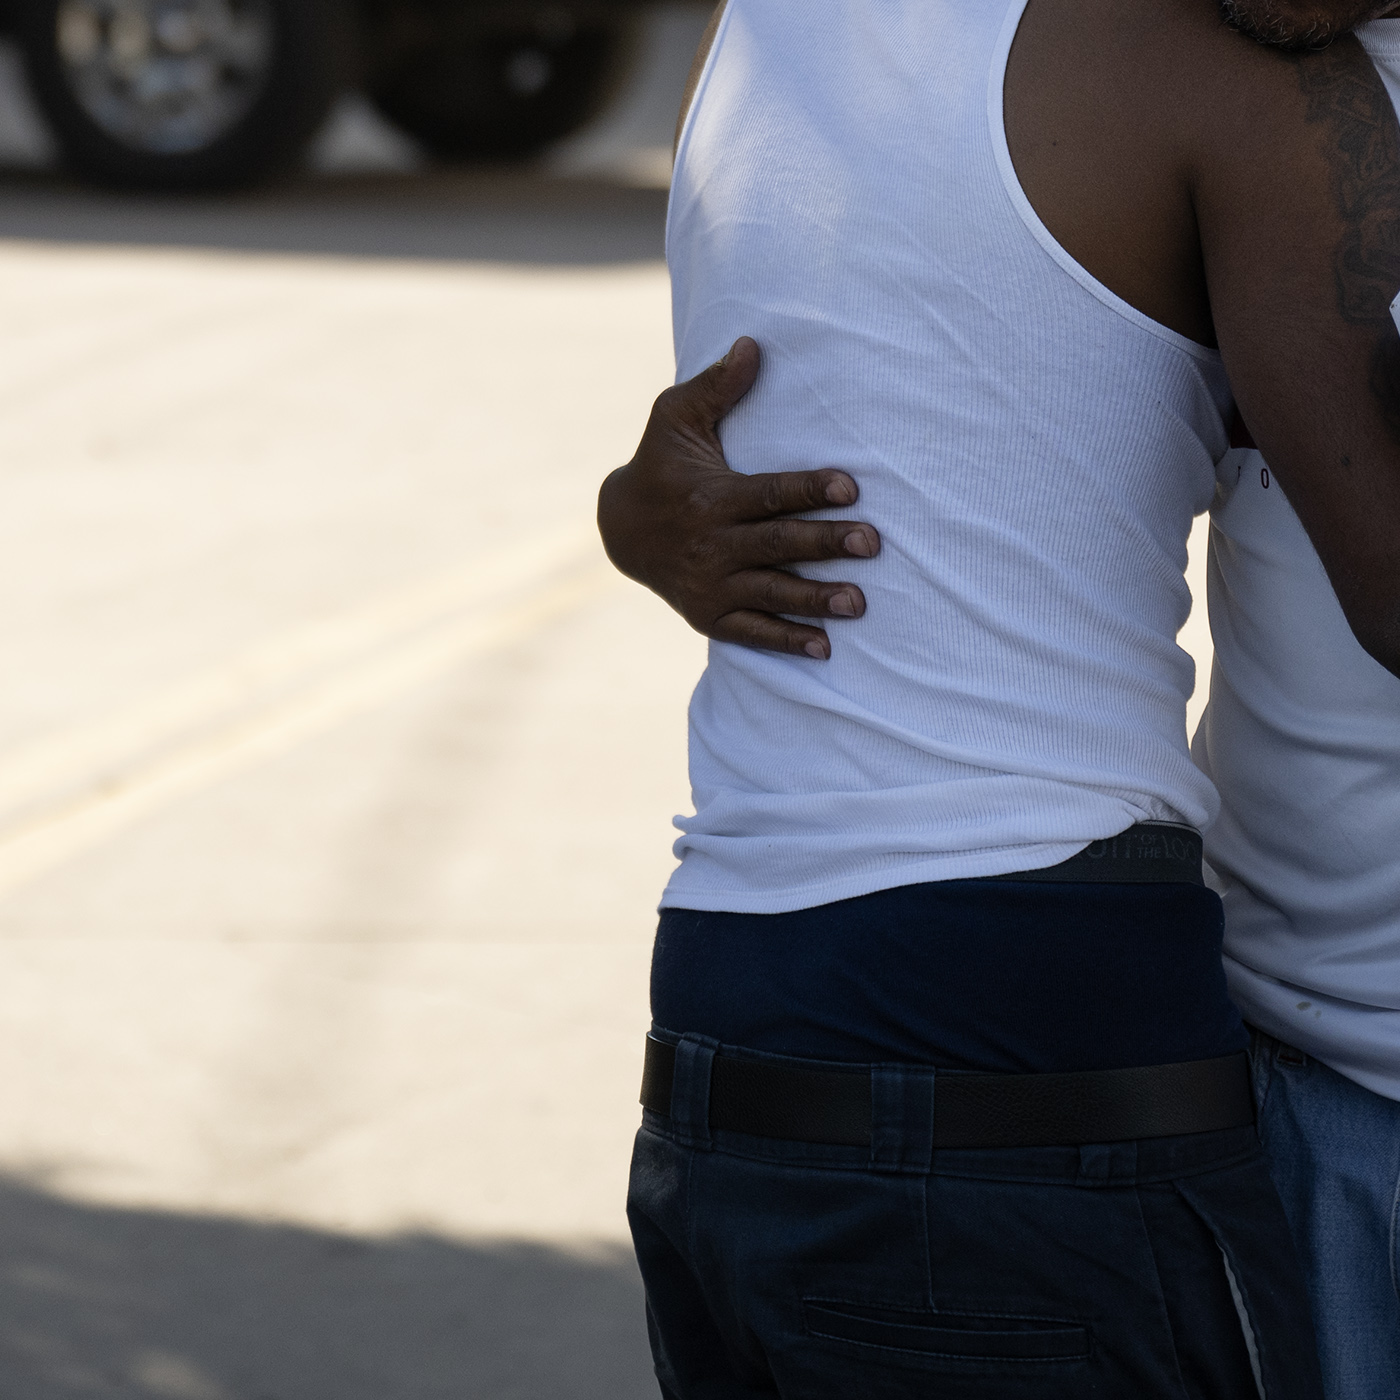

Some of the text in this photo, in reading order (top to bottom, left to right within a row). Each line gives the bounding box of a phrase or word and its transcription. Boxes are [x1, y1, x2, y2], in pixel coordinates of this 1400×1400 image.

[1140, 833, 1158, 845] OF
[1078, 834, 1131, 859] UIT
[1137, 846, 1162, 859] THE
